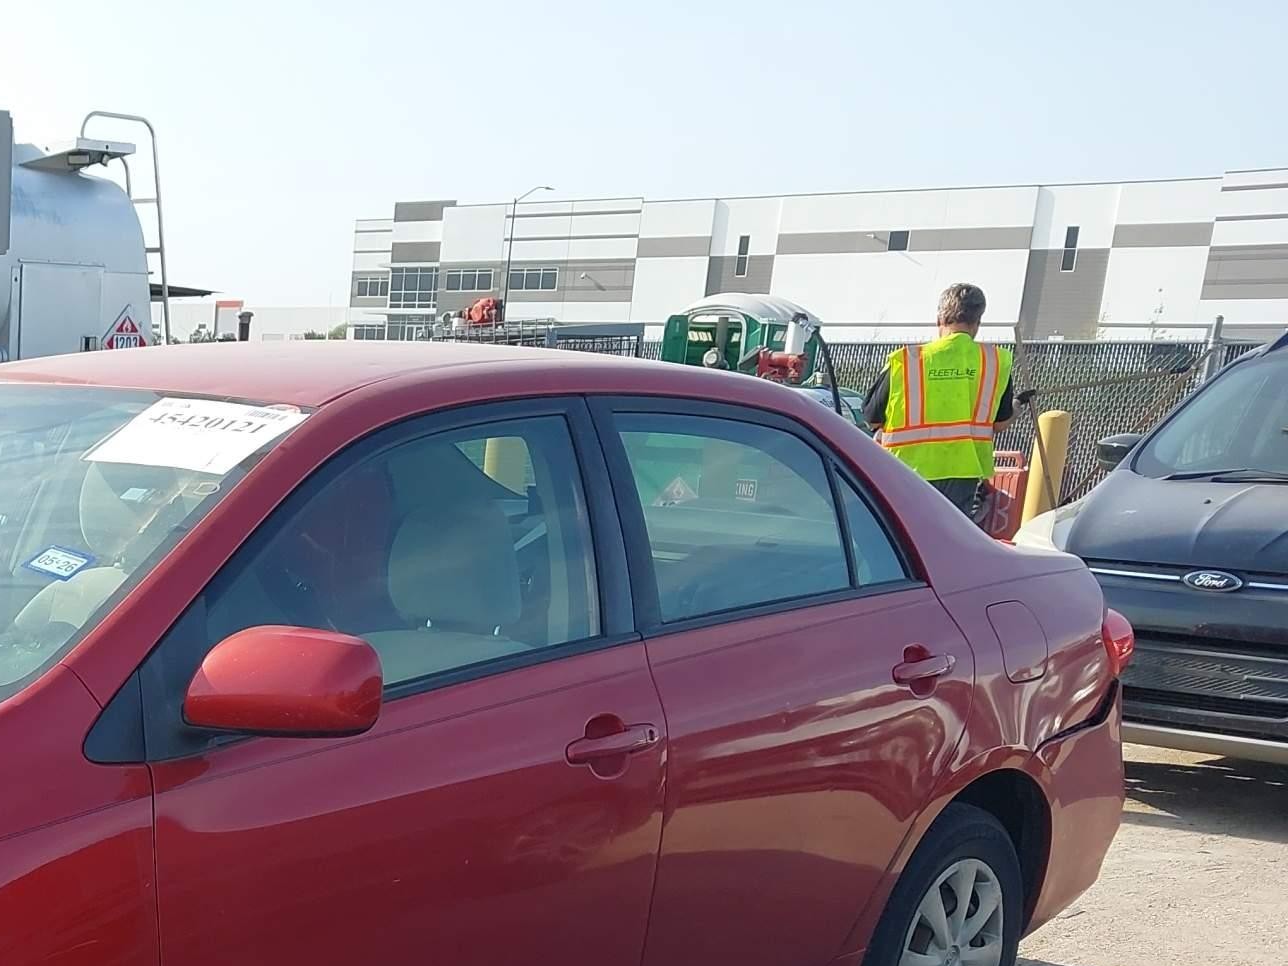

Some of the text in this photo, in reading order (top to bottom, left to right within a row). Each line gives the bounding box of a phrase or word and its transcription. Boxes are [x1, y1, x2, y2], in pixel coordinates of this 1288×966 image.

[115, 336, 138, 349] 1203
[149, 412, 267, 434] 45420121
[1194, 573, 1229, 588] Ford
